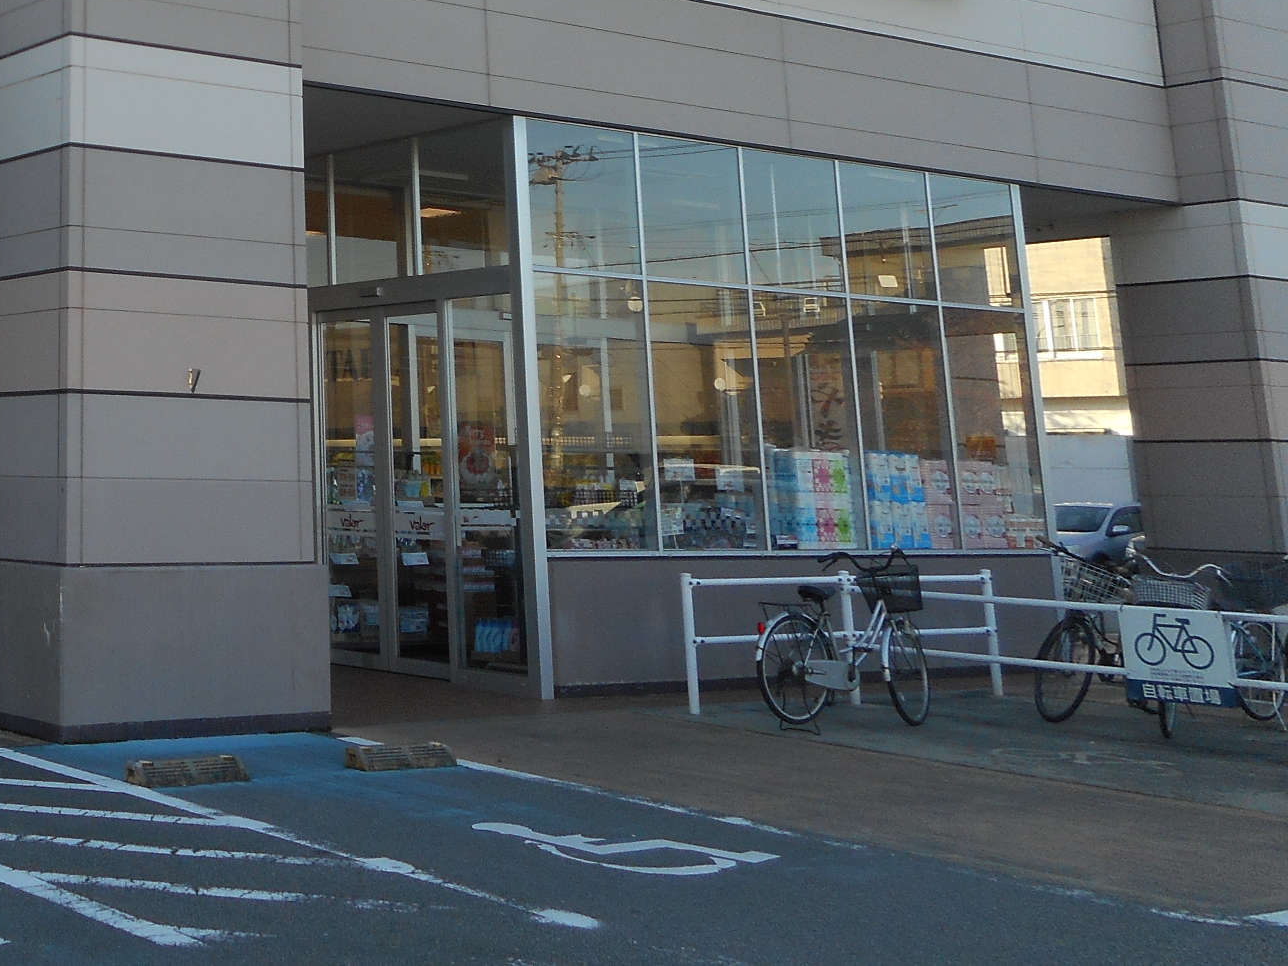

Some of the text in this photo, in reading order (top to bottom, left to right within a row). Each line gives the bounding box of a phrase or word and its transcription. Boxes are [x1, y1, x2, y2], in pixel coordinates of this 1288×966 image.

[1142, 682, 1222, 706] 自転車置場
